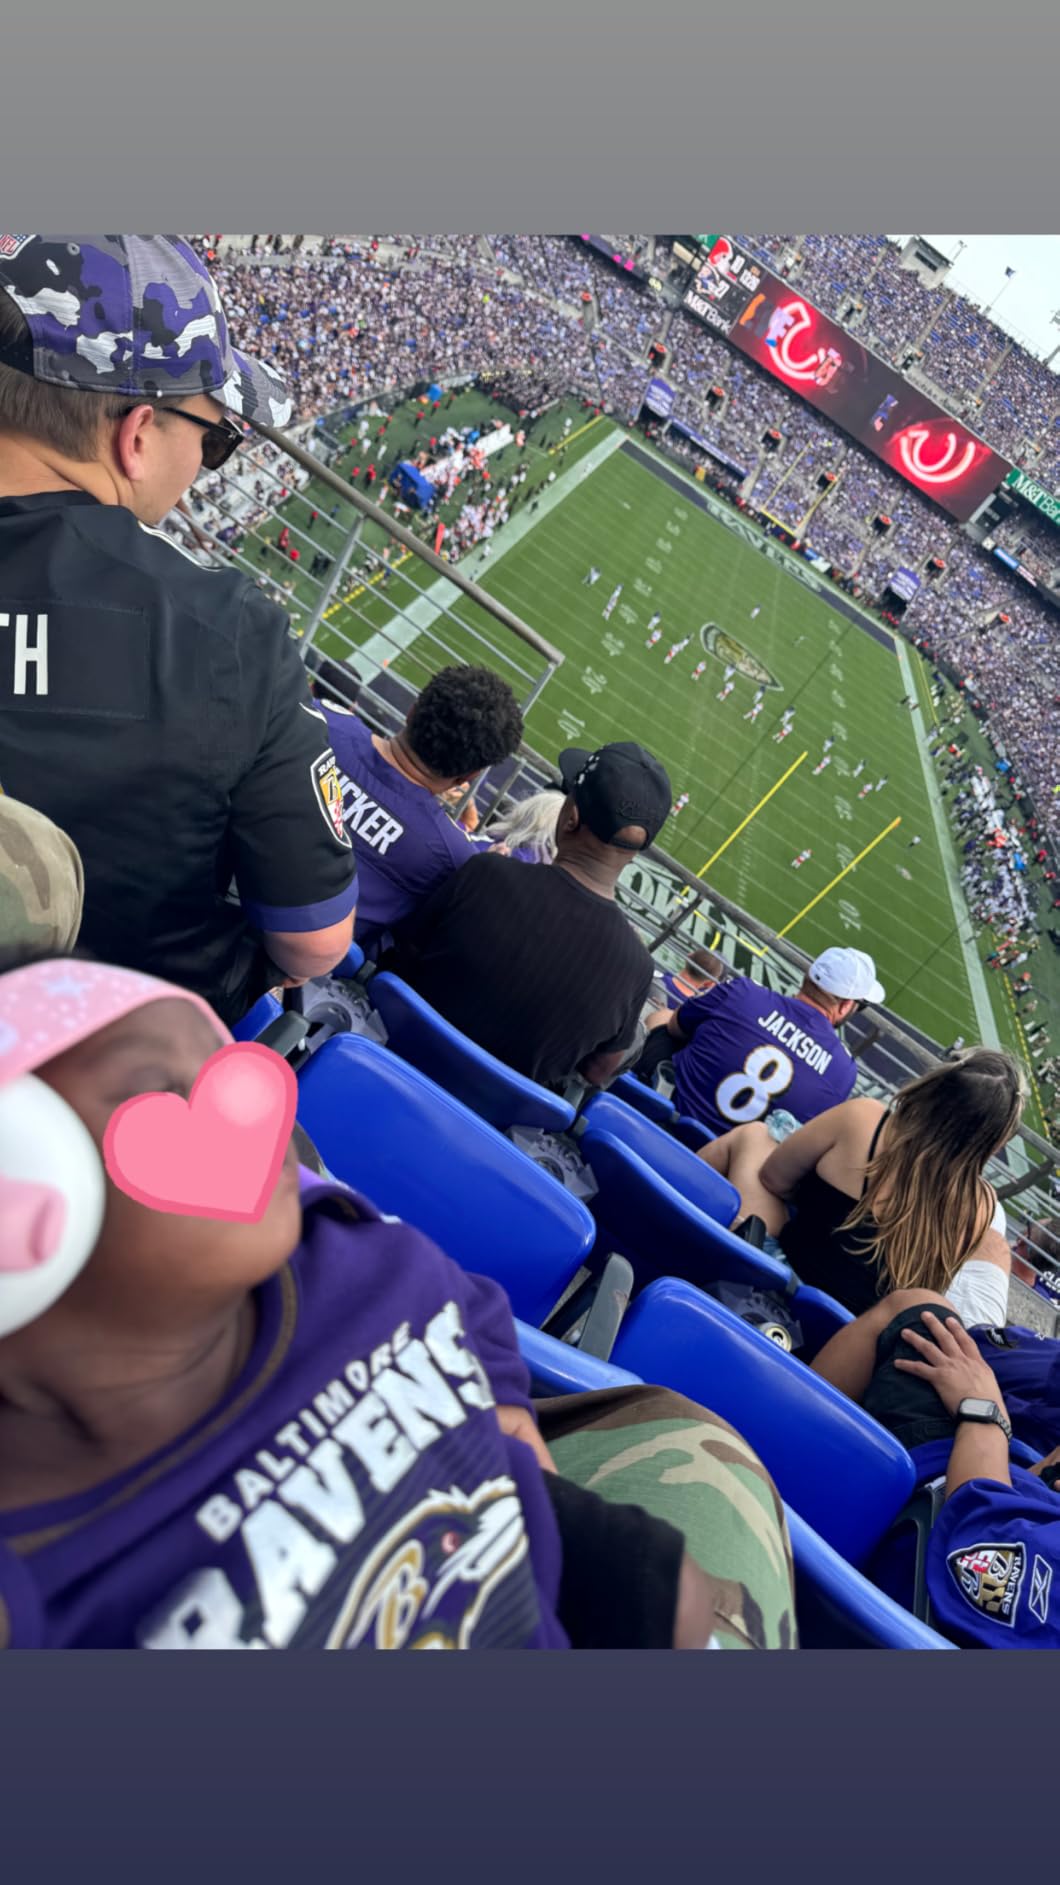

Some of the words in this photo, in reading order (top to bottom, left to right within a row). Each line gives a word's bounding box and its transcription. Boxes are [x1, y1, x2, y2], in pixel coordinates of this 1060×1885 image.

[1011, 473, 1047, 505] M&T
[758, 1010, 833, 1075] JACKSON
[715, 1044, 794, 1123] 8
[196, 1321, 411, 1543] BALTIMORE
[142, 1300, 496, 1649] RAVENS
